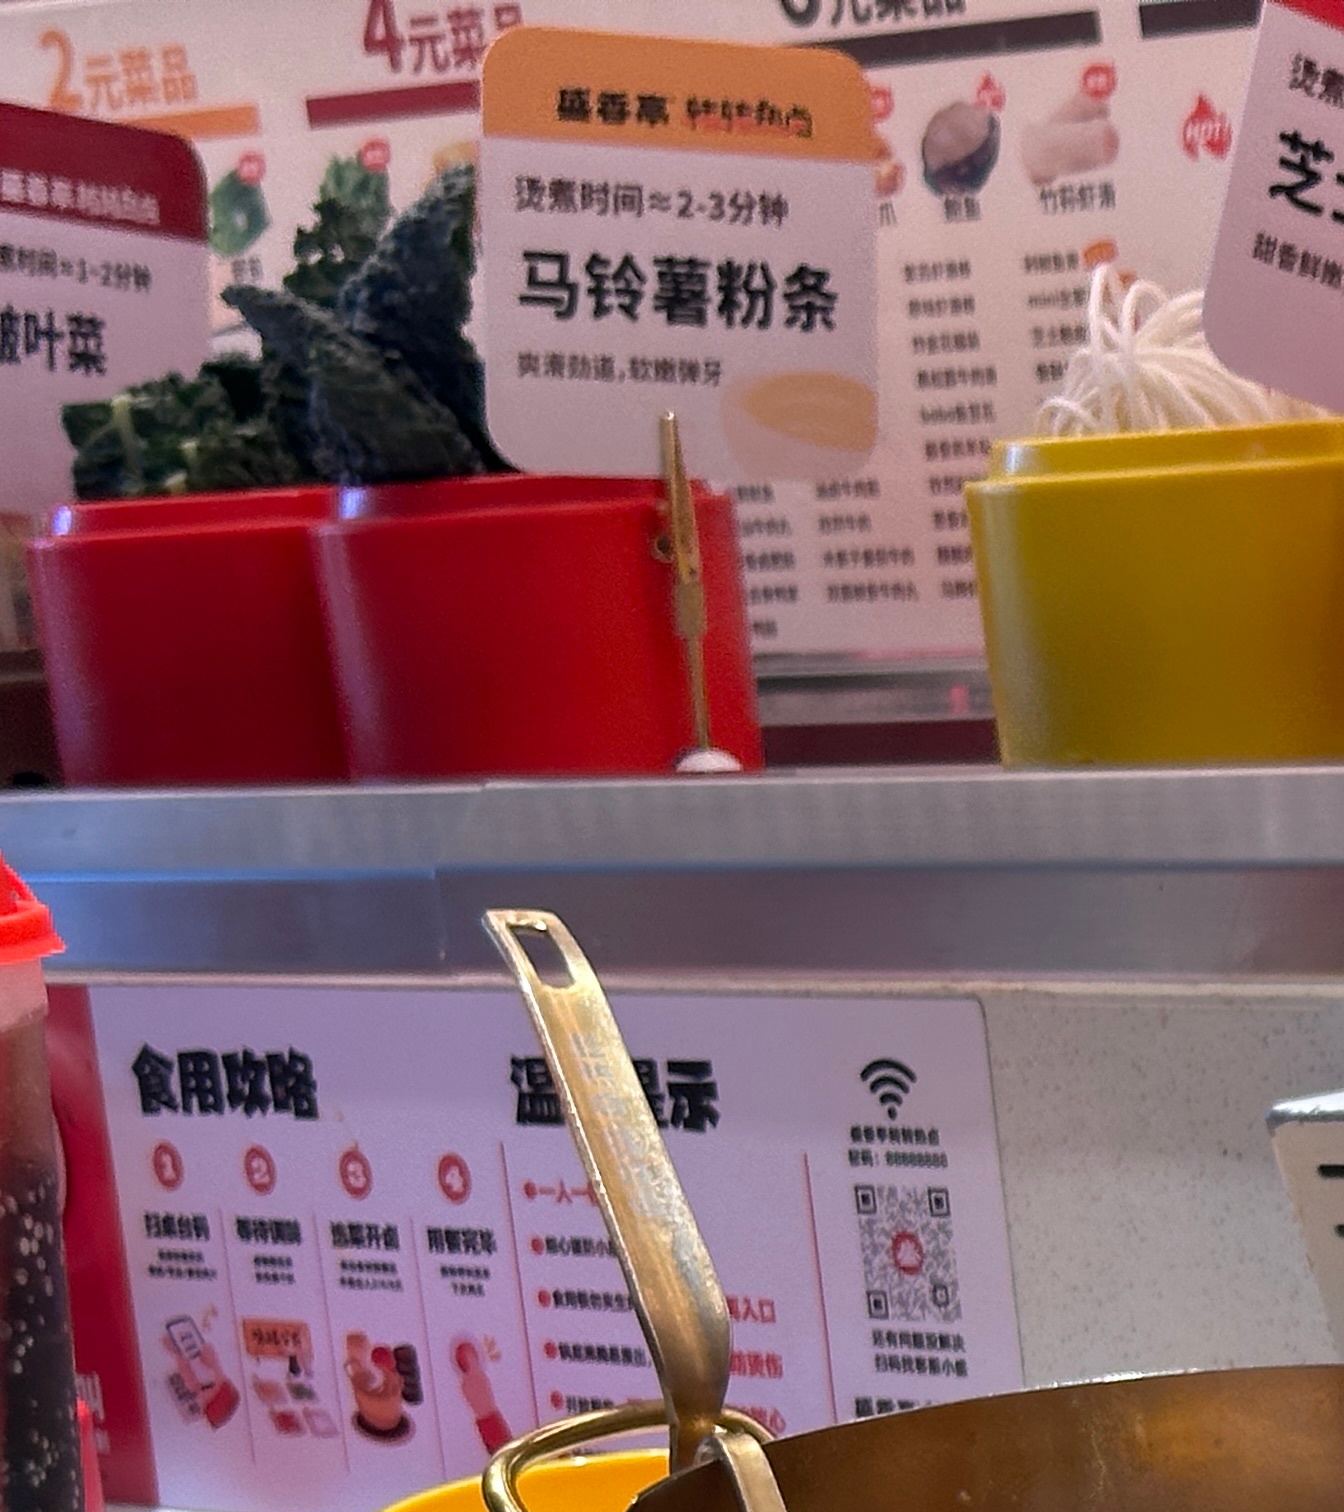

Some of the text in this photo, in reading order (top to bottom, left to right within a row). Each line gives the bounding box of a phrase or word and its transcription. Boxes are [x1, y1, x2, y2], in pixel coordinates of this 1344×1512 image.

[39, 26, 197, 110] 2元菜品
[518, 249, 838, 332] 马铃薯粉条
[132, 1042, 320, 1123] 食用攻略
